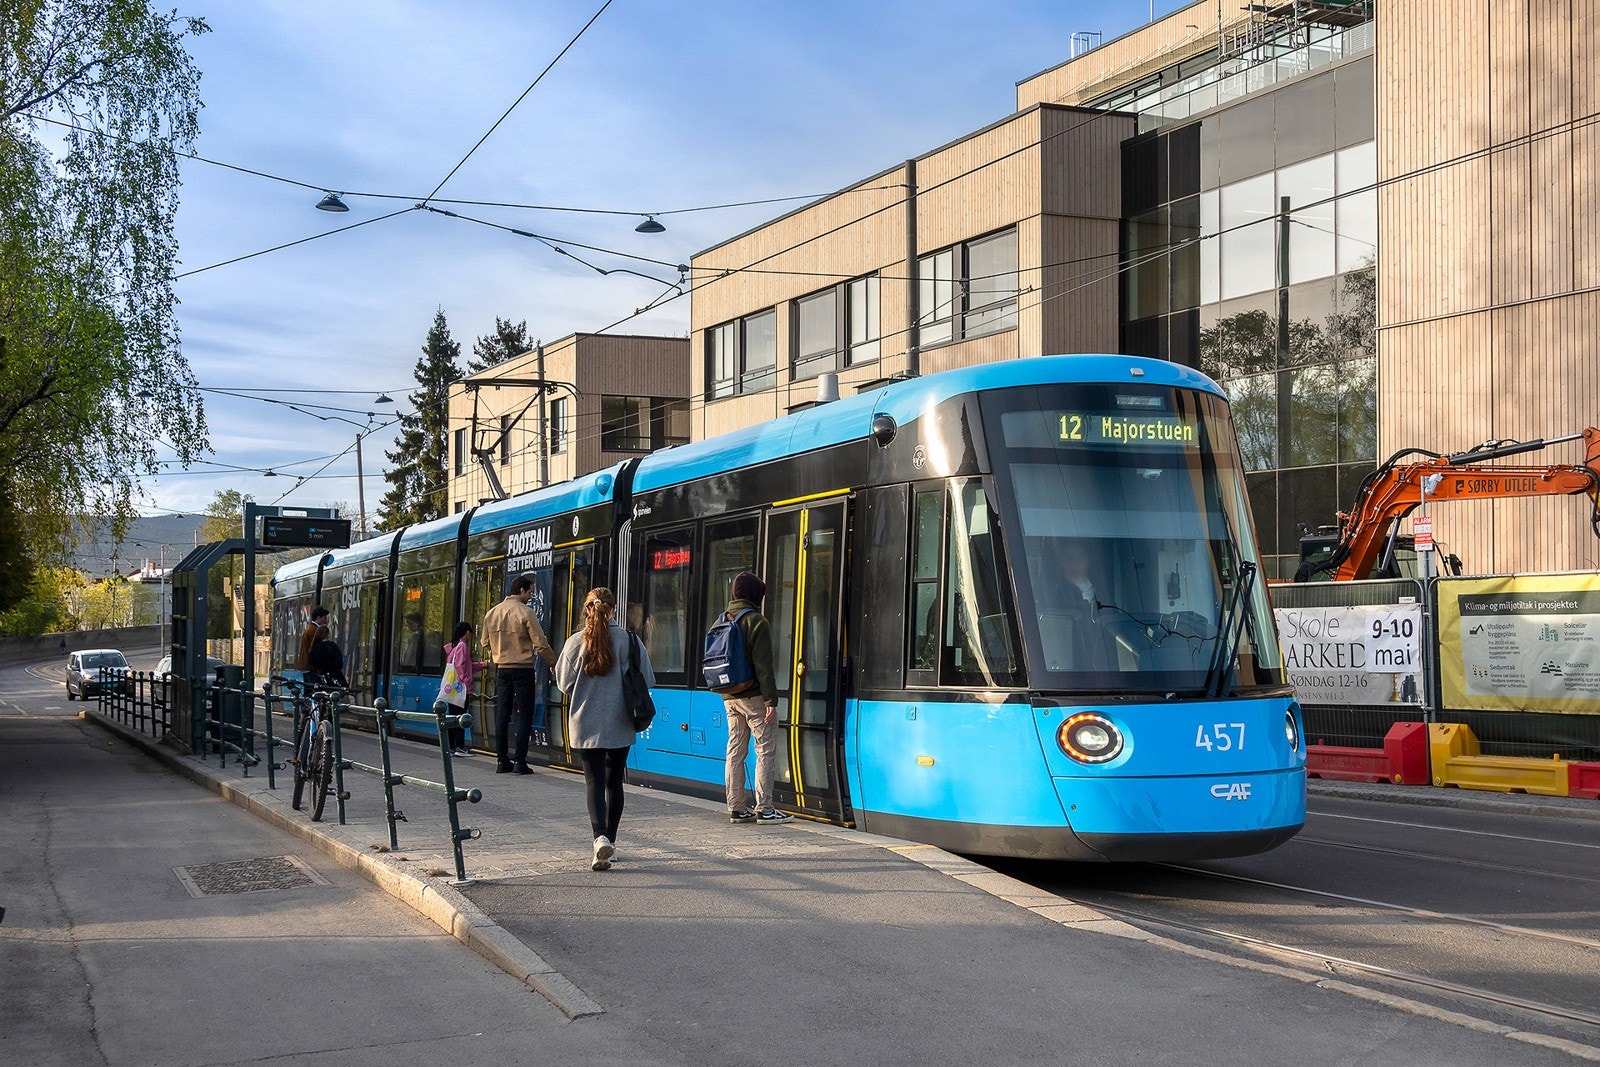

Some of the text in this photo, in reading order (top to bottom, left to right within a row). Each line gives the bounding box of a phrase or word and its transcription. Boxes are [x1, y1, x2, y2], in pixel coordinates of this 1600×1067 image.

[1059, 415, 1193, 444] 12 Majorstuen
[1467, 477, 1537, 494] SØRBY UTLEIE
[1413, 517, 1432, 525] ALARM
[506, 526, 553, 557] FOOTBALL
[507, 550, 553, 572] BETTER WITH
[1489, 603, 1498, 612] og
[1537, 600, 1579, 611] prosjektet
[1287, 611, 1340, 638] Skole
[1372, 618, 1413, 639] 9-10
[1375, 643, 1412, 666] mai
[1290, 674, 1368, 688] SØNDAG 12-16
[1339, 691, 1345, 701] 3
[1195, 723, 1246, 752] 457
[1210, 783, 1252, 801] CAF
